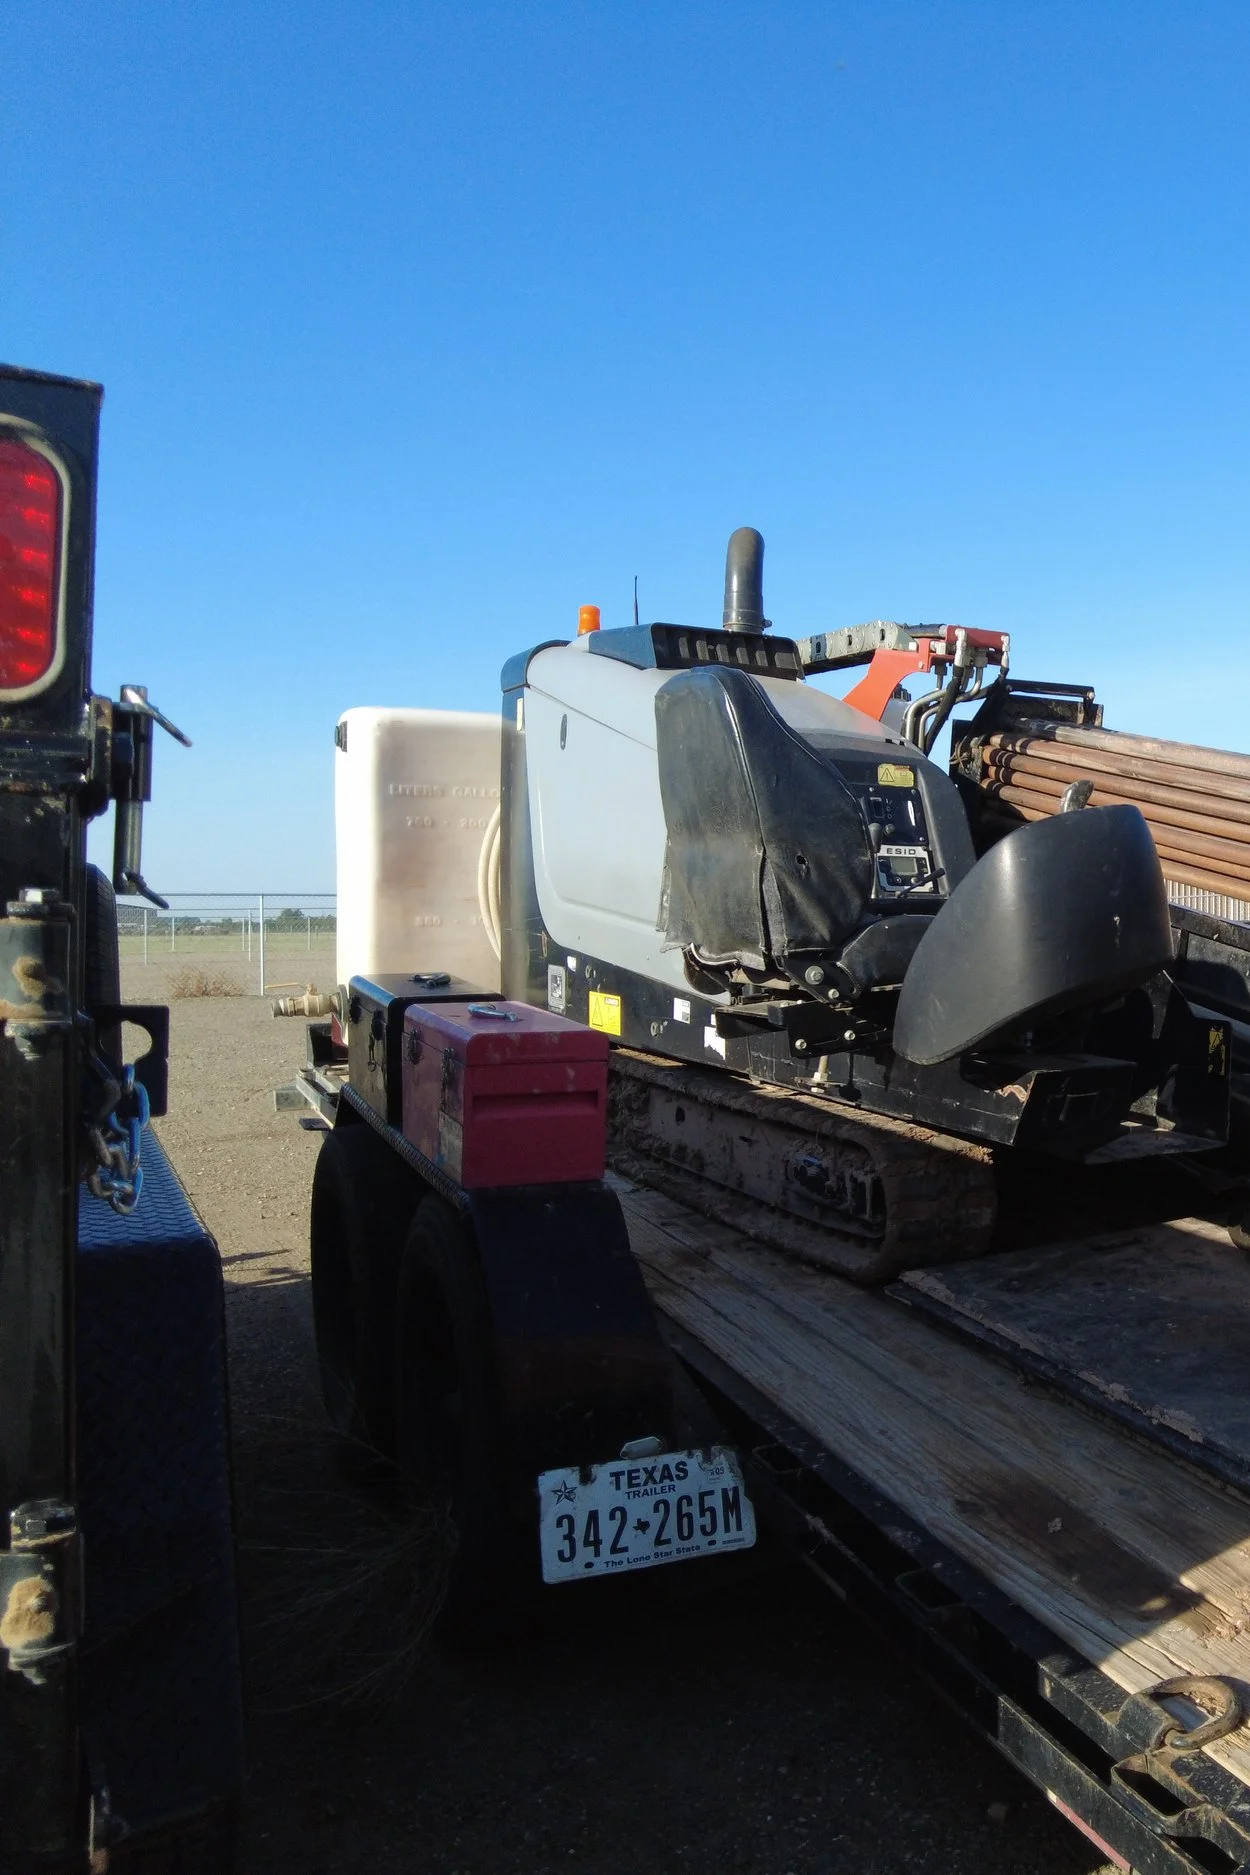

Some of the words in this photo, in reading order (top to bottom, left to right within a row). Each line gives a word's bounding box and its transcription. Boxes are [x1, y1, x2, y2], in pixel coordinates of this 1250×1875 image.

[609, 1461, 689, 1491] TEXAS
[625, 1484, 676, 1500] TRAILER
[603, 1559, 624, 1569] The
[626, 1554, 651, 1565] Lone
[653, 1550, 673, 1560] Star
[675, 1544, 701, 1555] State
